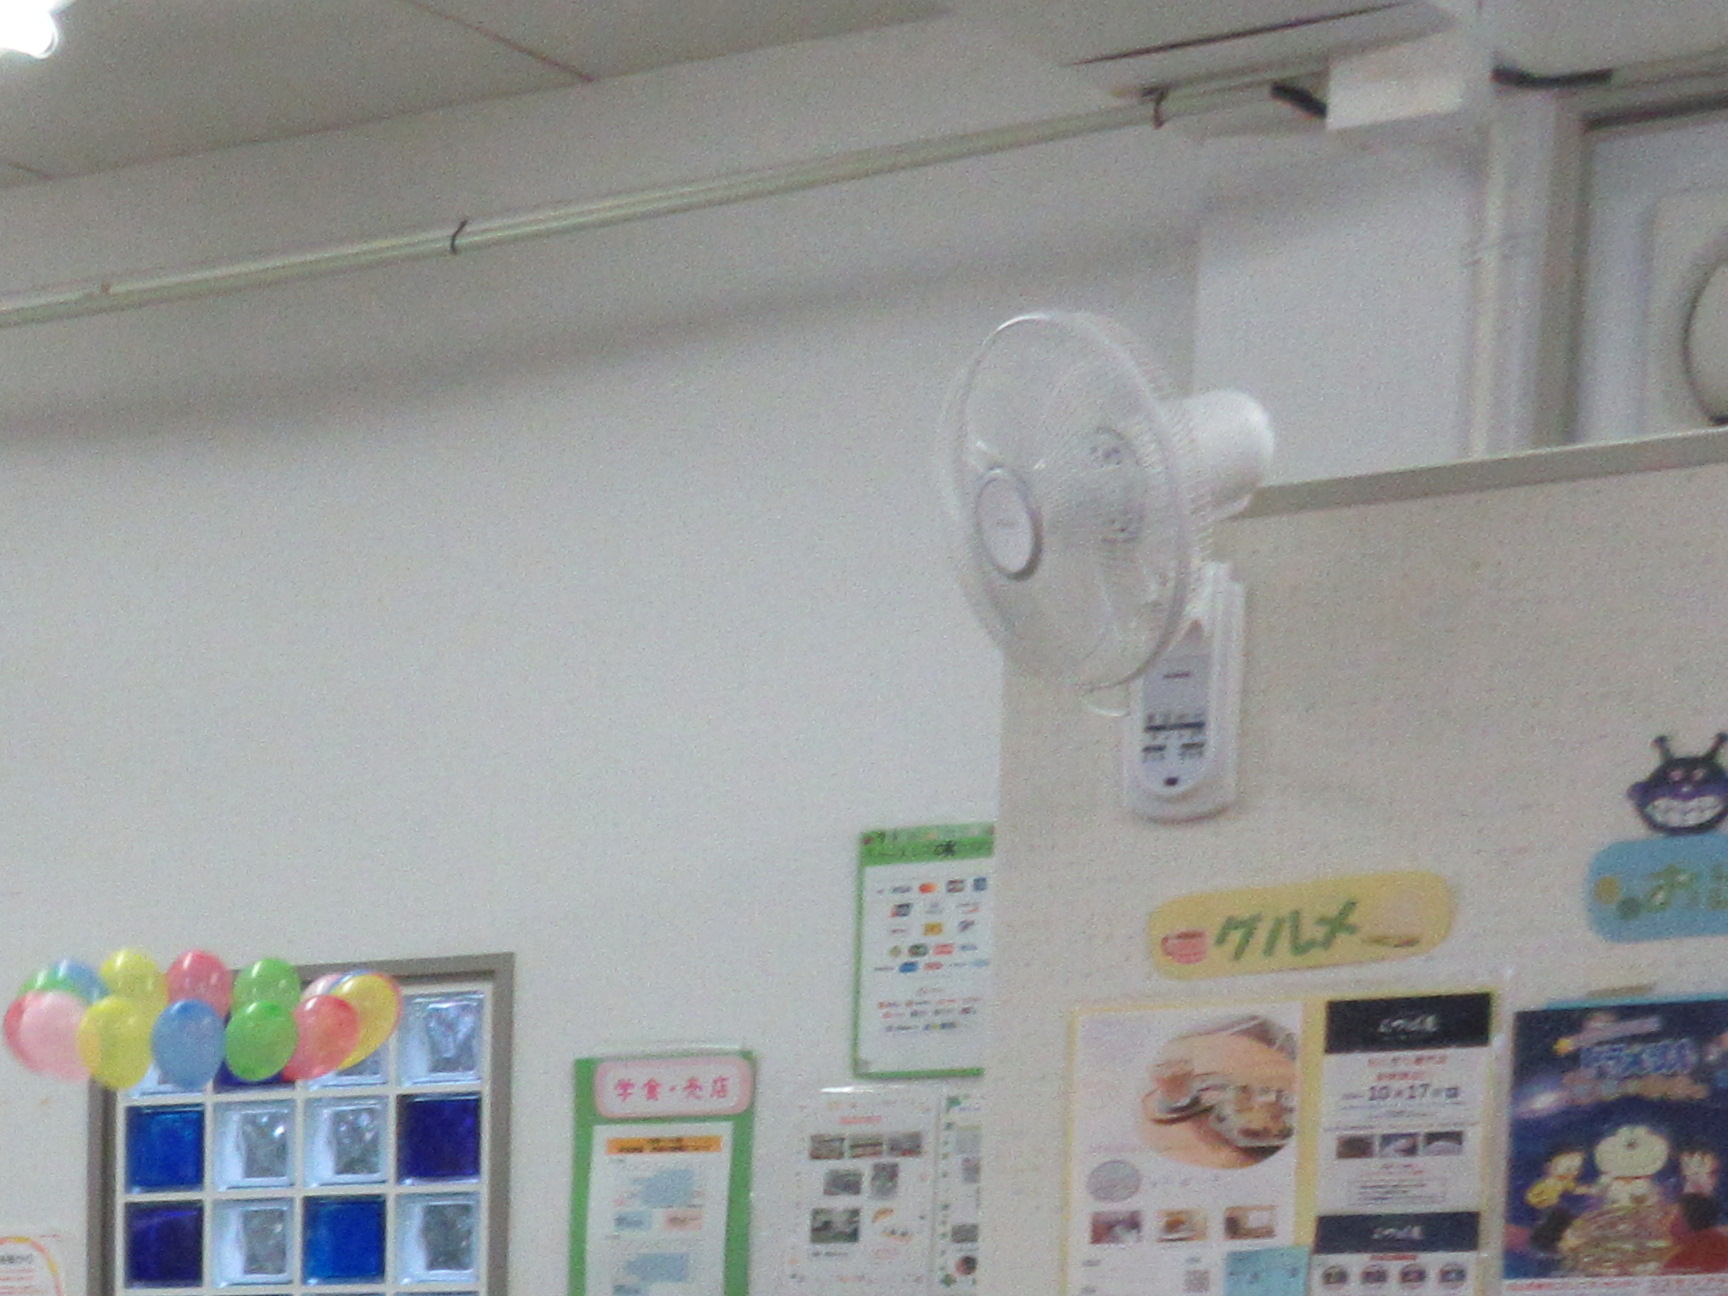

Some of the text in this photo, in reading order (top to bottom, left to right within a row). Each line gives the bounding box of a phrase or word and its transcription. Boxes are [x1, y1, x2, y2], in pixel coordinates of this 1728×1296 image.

[614, 1076, 730, 1102] 学食・売店
